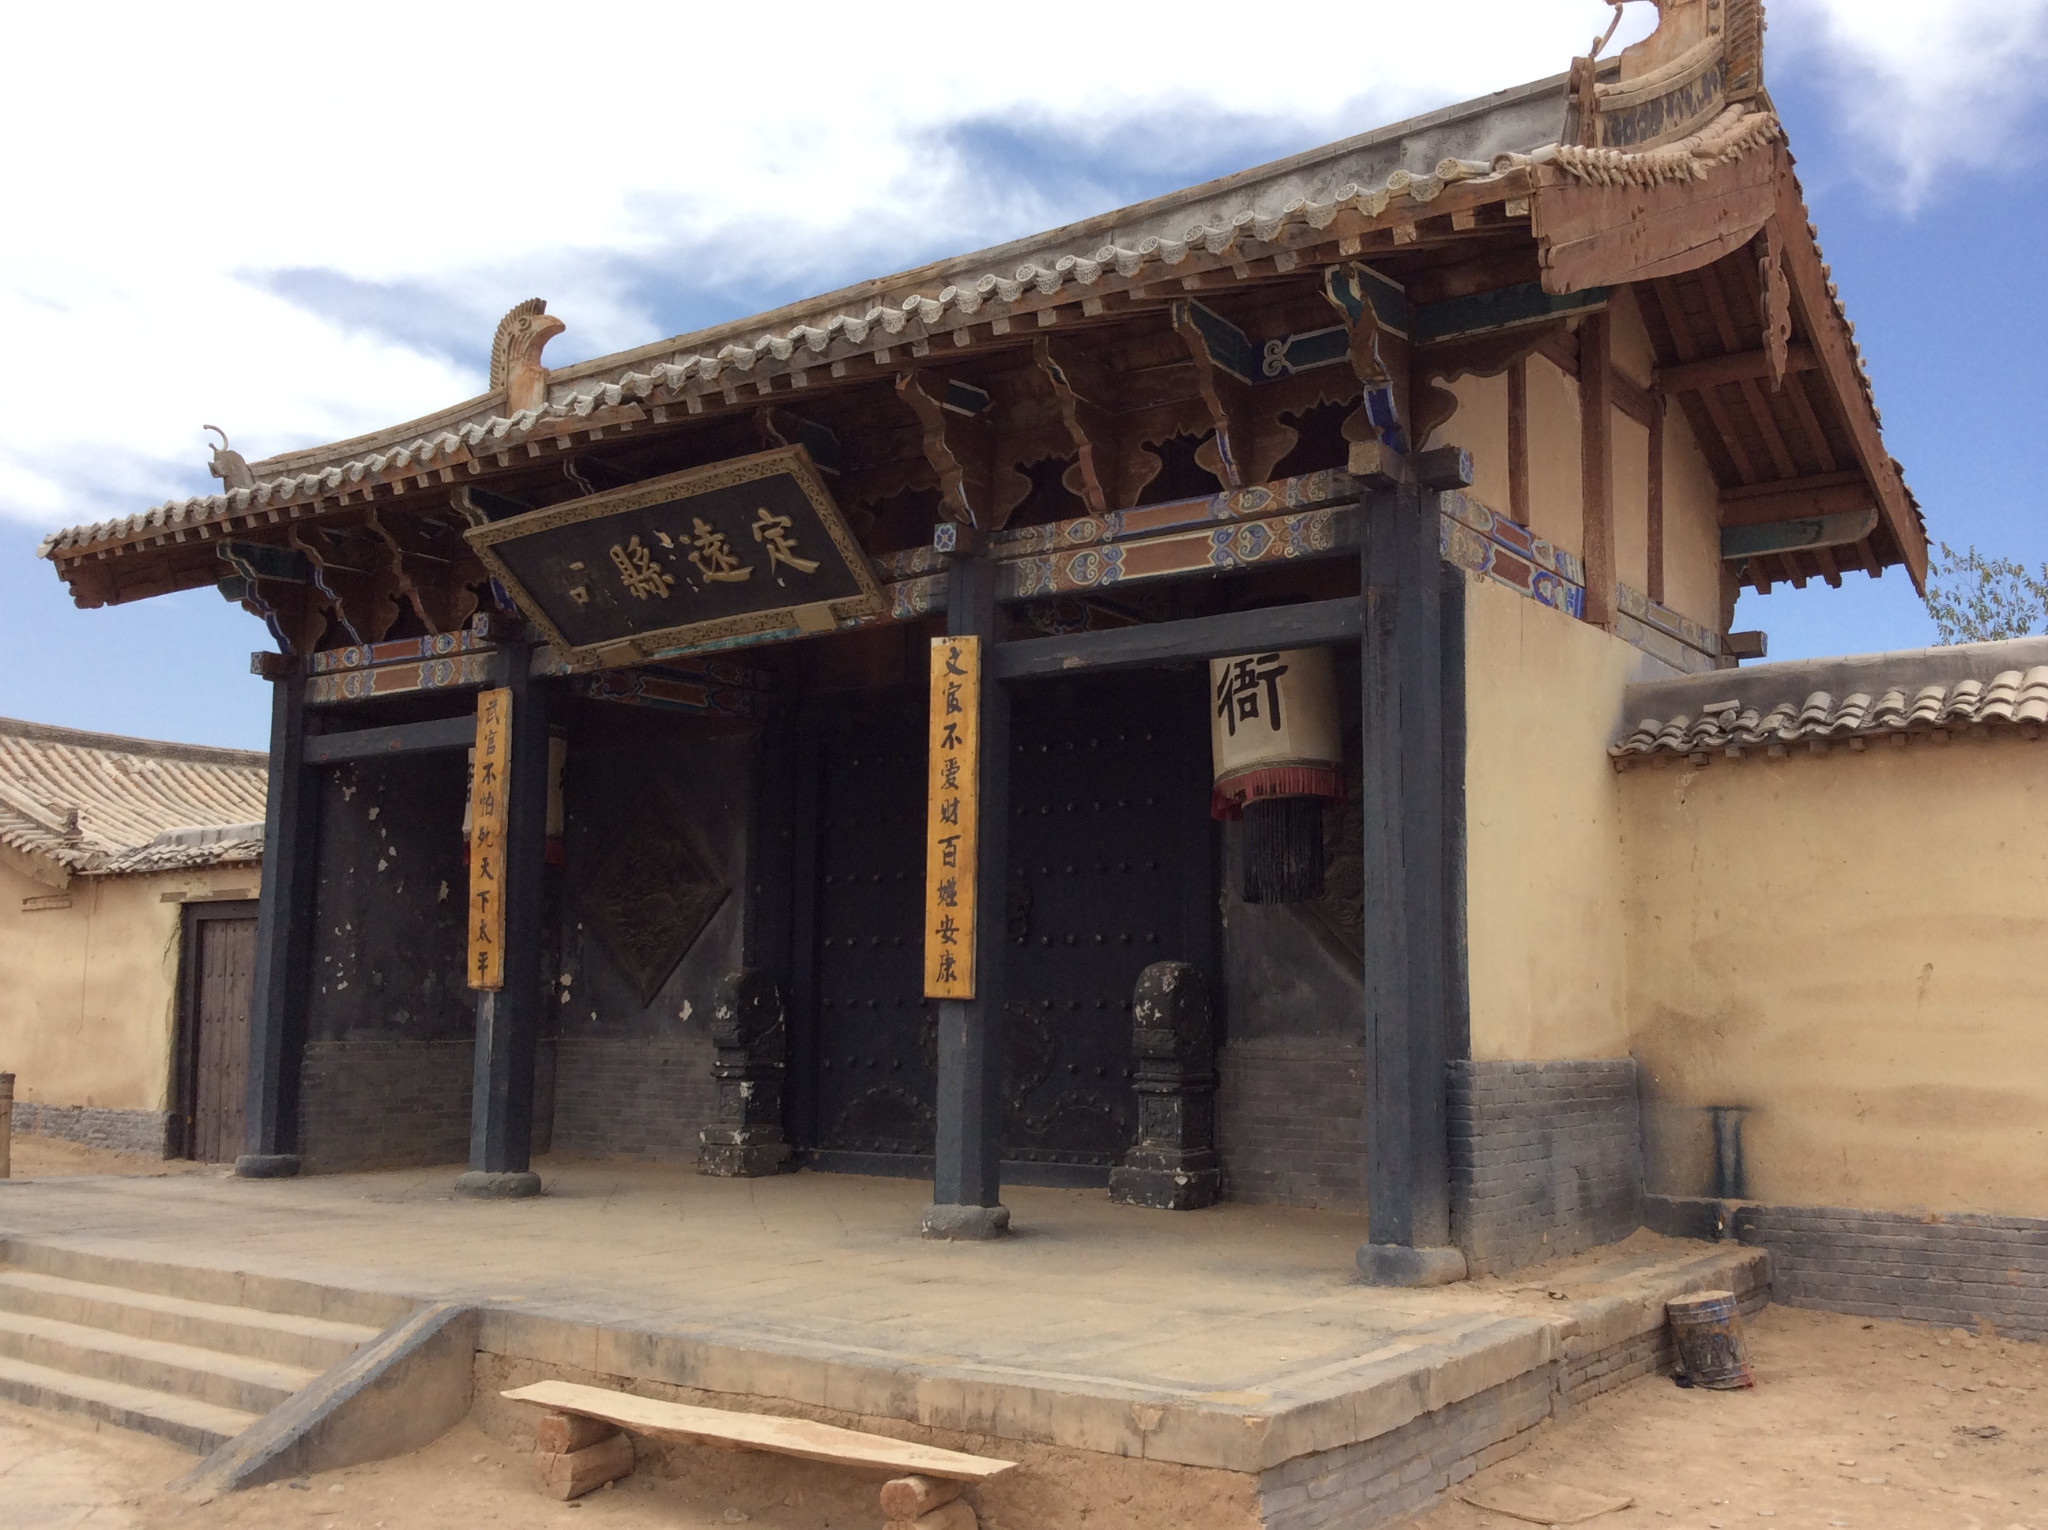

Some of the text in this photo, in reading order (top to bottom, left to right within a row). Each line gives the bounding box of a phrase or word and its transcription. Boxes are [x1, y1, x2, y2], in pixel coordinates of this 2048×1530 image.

[568, 506, 822, 606] 定遠縣
[1216, 652, 1289, 737] 衙
[475, 698, 501, 985] 武官不怕死天下太平
